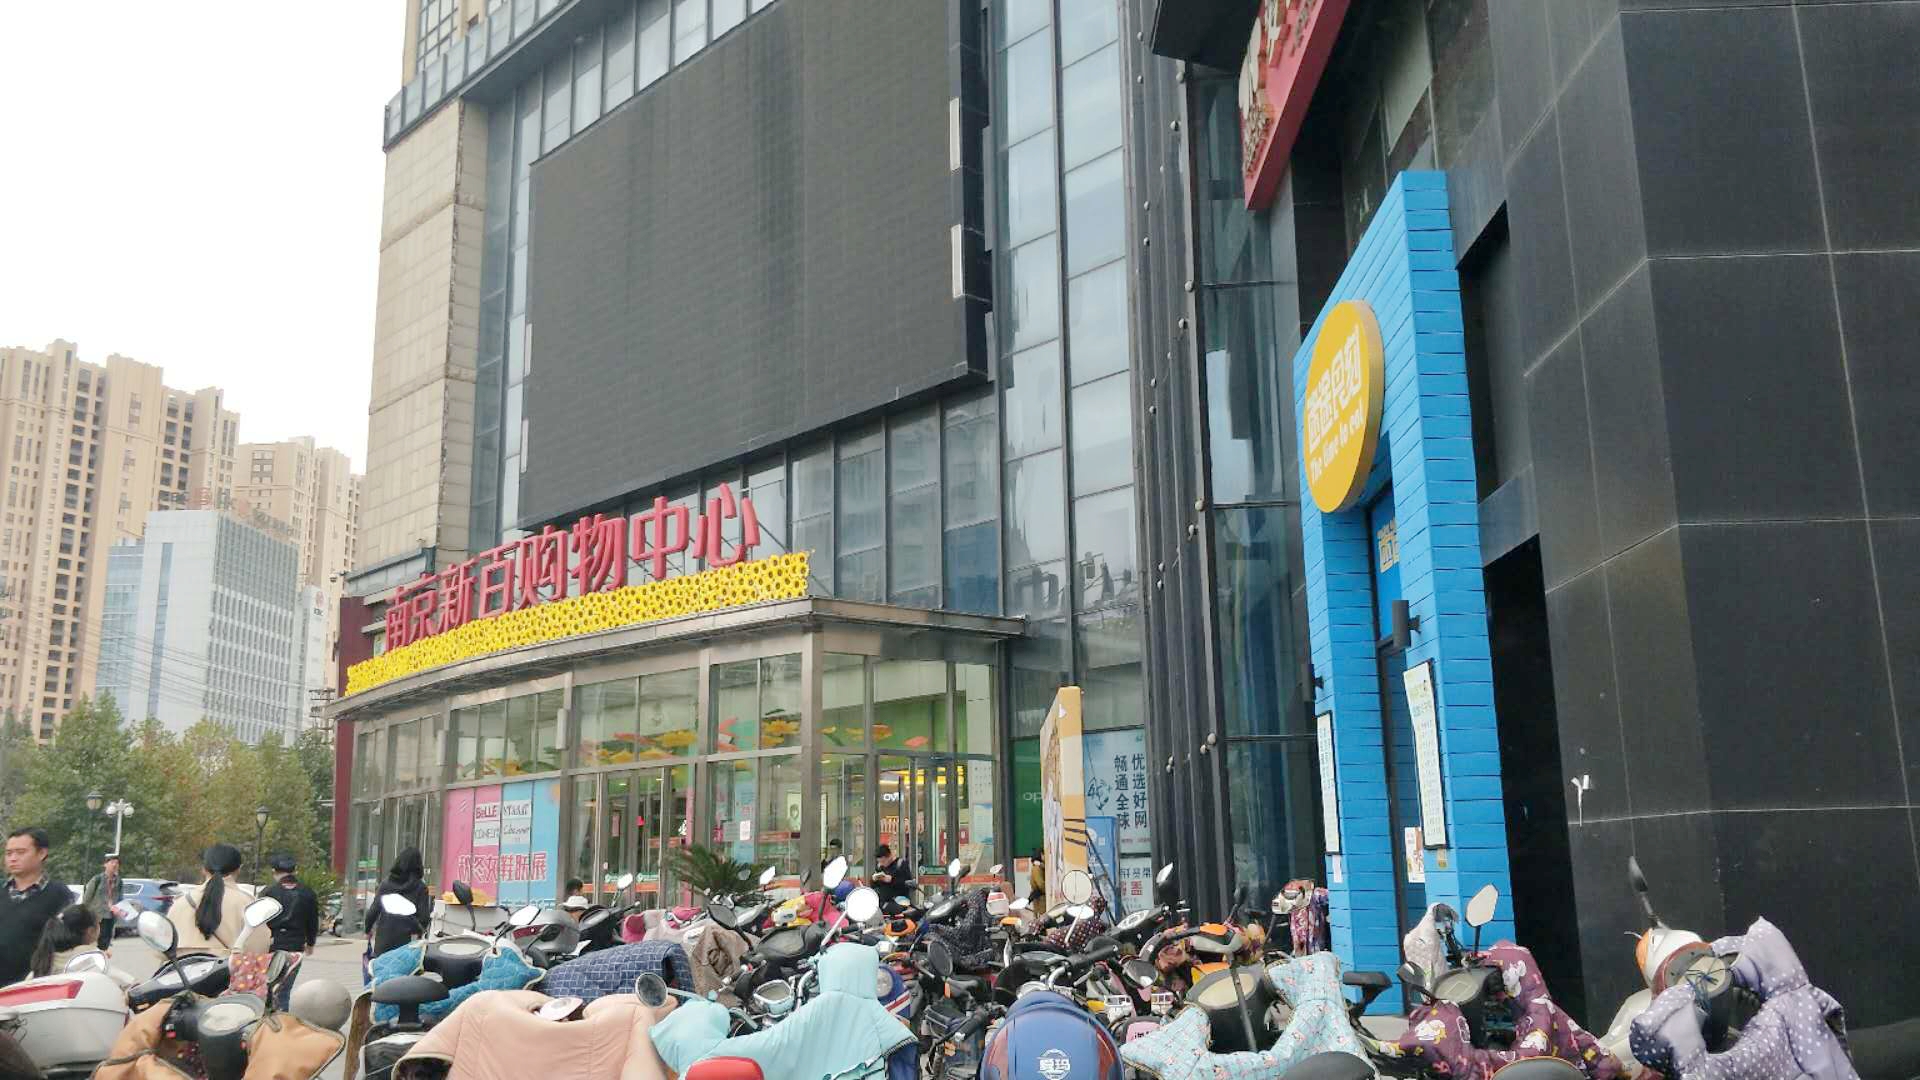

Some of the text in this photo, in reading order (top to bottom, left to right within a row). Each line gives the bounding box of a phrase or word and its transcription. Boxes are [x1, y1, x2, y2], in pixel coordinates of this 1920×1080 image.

[384, 483, 760, 652] 南京新百购物中心
[1114, 754, 1130, 830] 畅通全球
[1131, 753, 1147, 828] 优选好网
